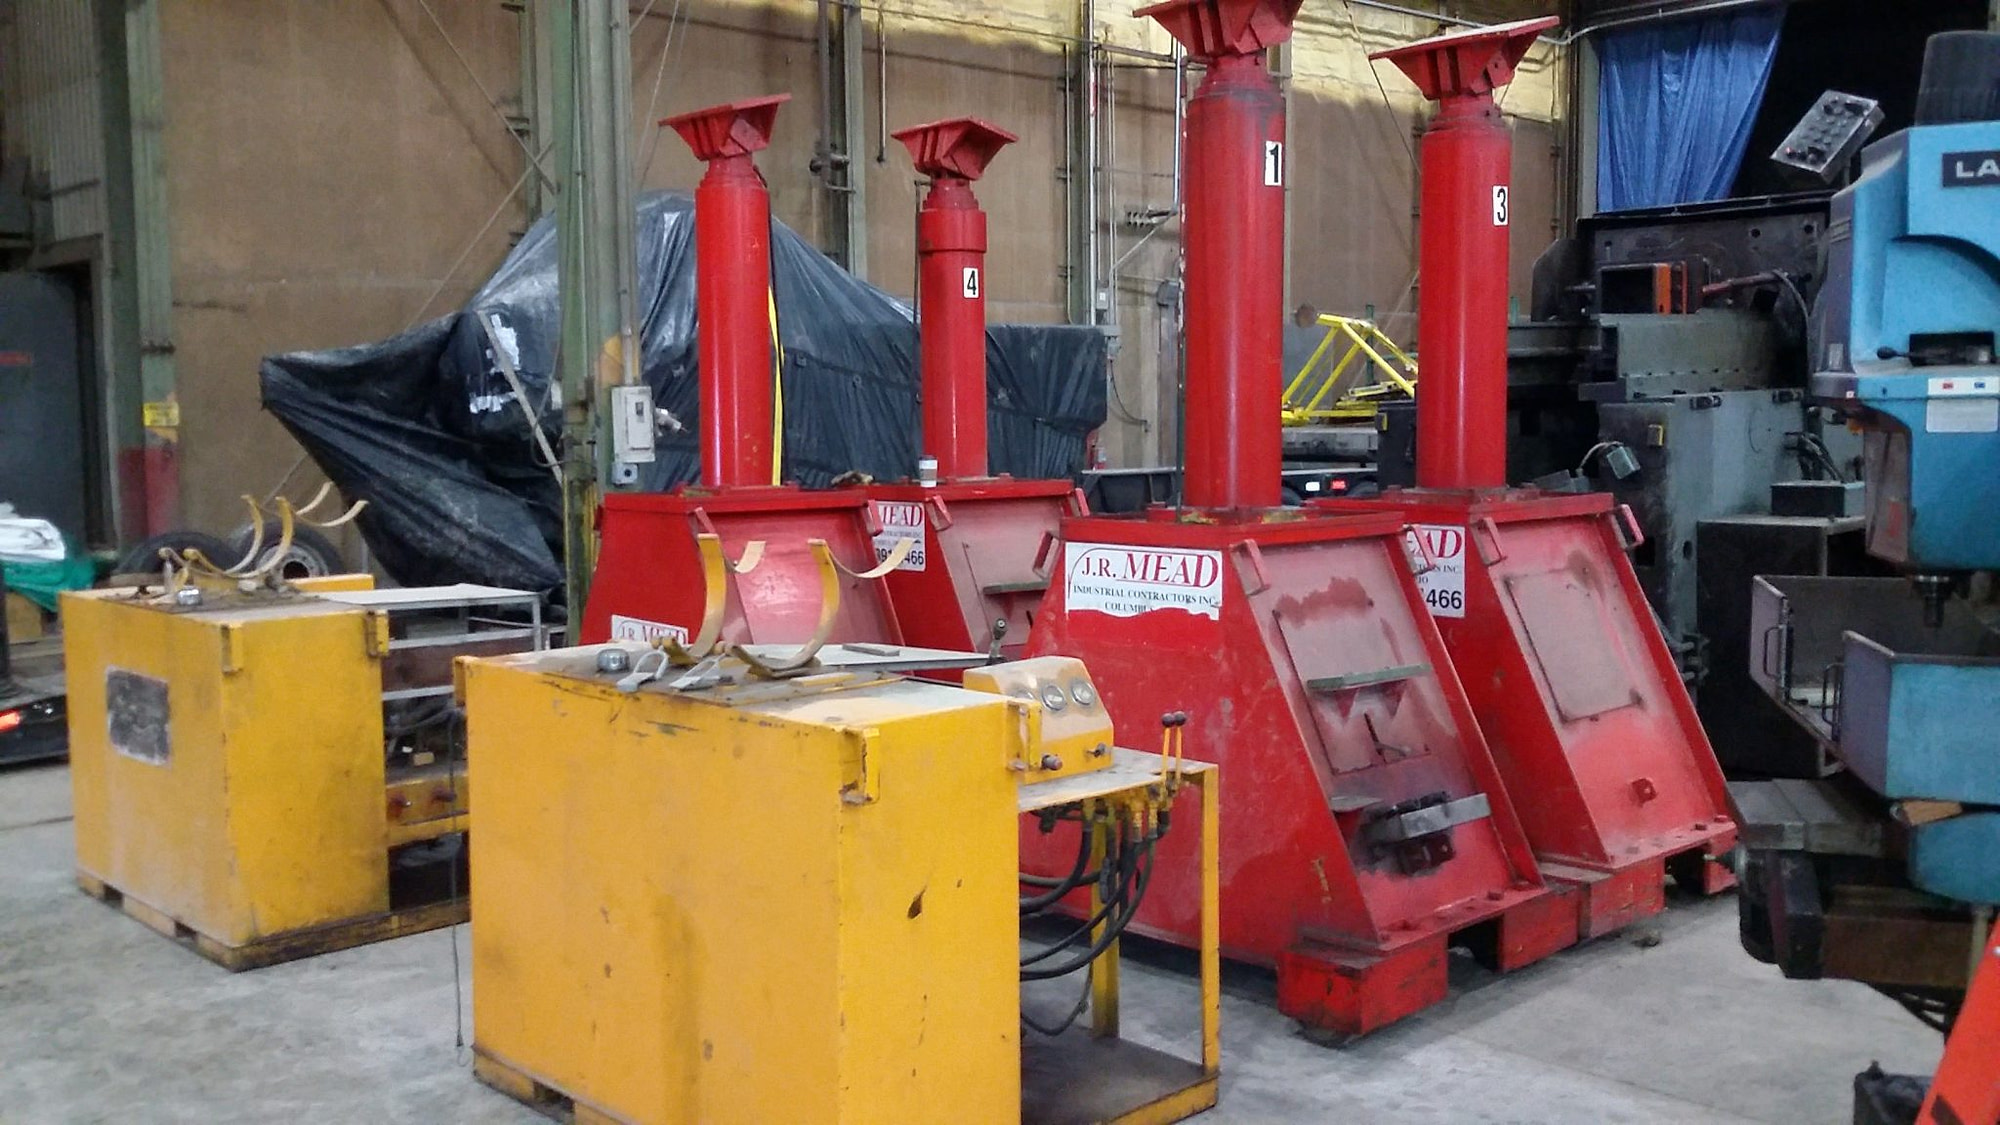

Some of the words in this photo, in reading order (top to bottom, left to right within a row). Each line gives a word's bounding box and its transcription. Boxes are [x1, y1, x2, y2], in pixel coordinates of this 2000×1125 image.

[1269, 144, 1279, 183] 1
[1497, 188, 1506, 222] 3
[967, 270, 977, 295] 4
[1082, 557, 1116, 578] J.R.
[1123, 552, 1219, 588] MEAD
[1074, 585, 1124, 598] INDUSTRIAL
[1128, 590, 1197, 604] CONTRACTORS
